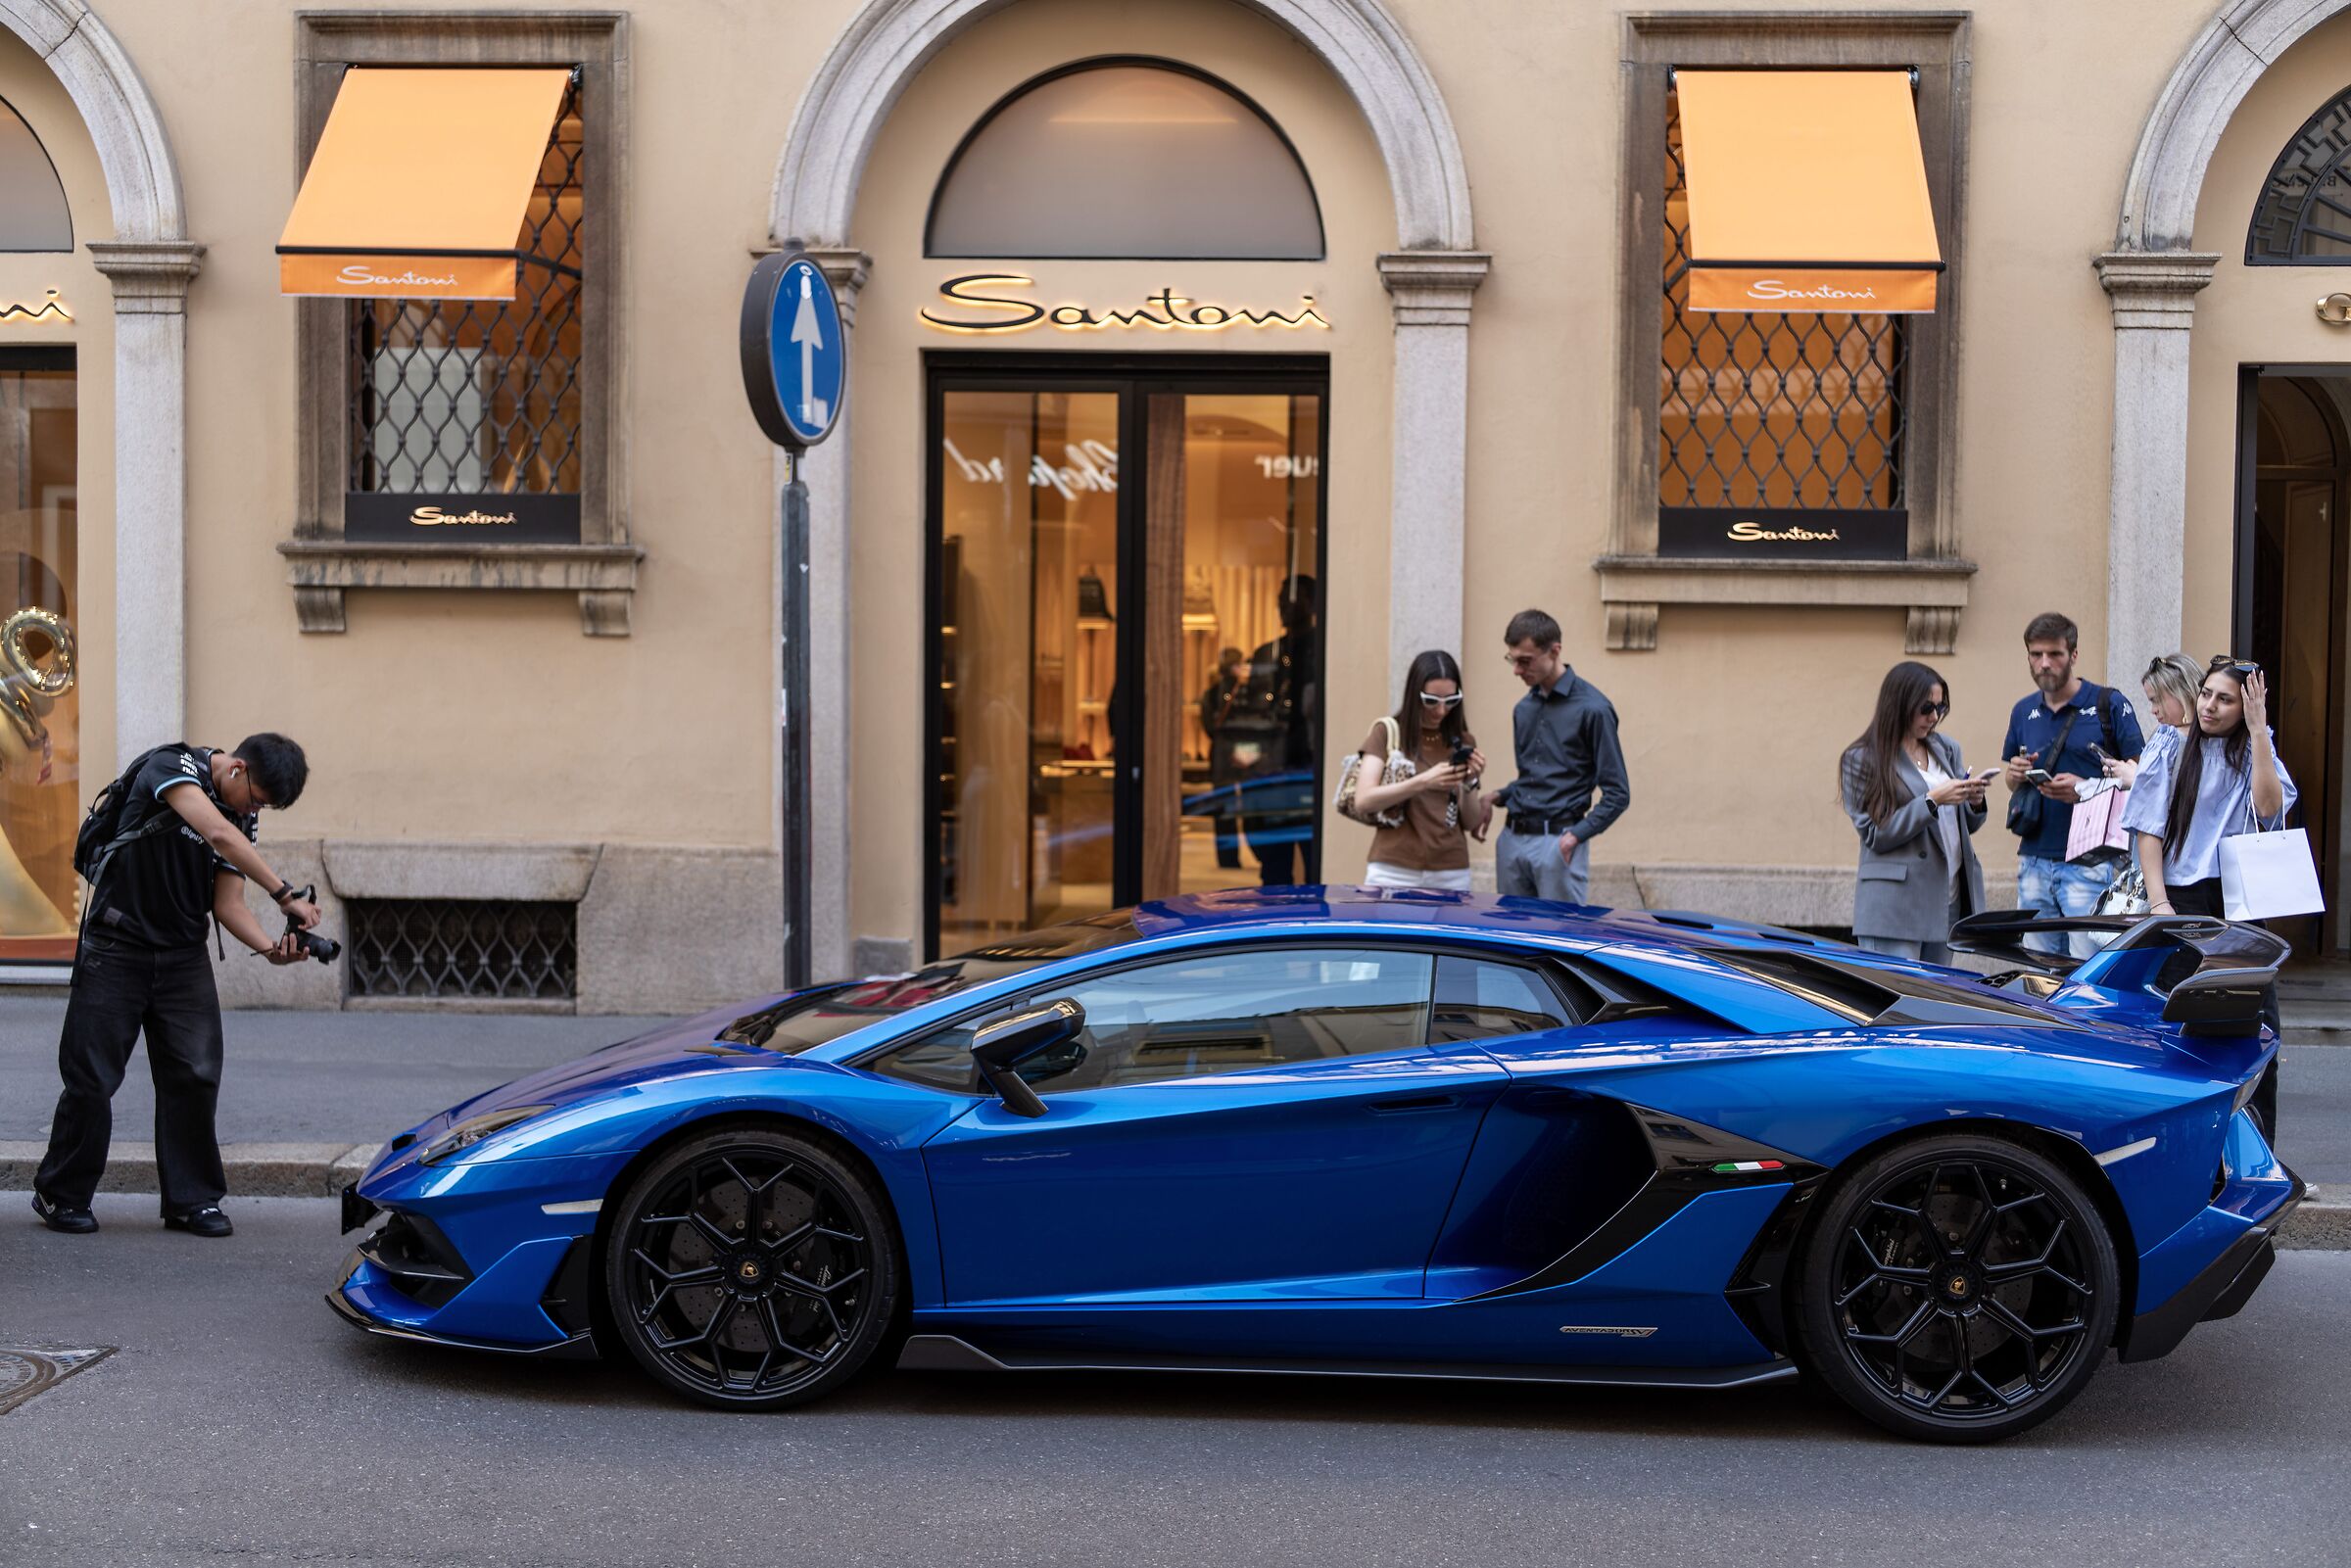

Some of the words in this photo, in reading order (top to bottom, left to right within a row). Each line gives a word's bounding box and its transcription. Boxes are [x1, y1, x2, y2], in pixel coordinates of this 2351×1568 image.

[336, 265, 458, 286] Santoni
[1747, 280, 1876, 300] Santoni
[920, 274, 1331, 331] Santoni
[409, 506, 517, 526] Santoni
[1727, 522, 1840, 541] Santoni
